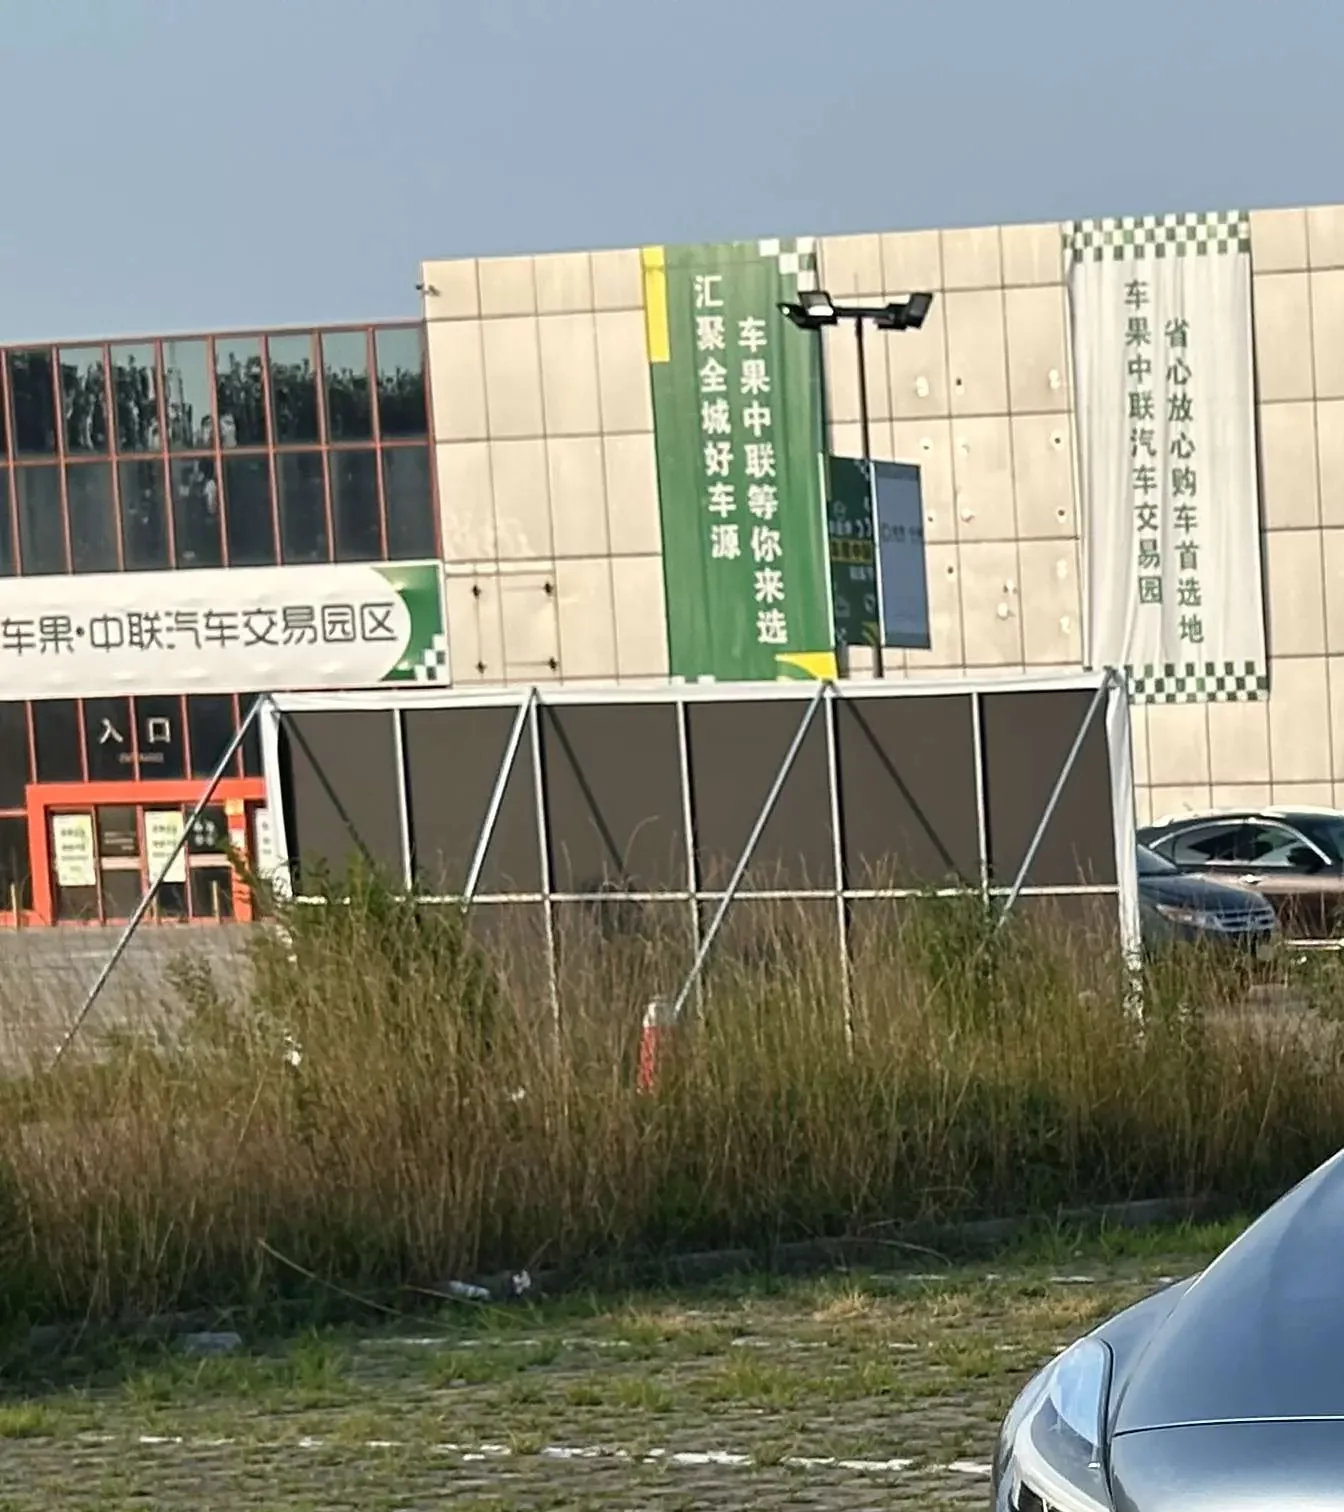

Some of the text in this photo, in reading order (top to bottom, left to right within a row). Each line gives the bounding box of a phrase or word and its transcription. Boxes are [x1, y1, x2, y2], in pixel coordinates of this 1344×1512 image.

[694, 274, 741, 560] 汇聚全城好车源
[737, 315, 788, 645] 车果中联等你来选
[1124, 279, 1164, 604] 车果中联汽车交易园
[1165, 318, 1204, 644] 省心放心购车首选地
[99, 717, 171, 745] 入口
